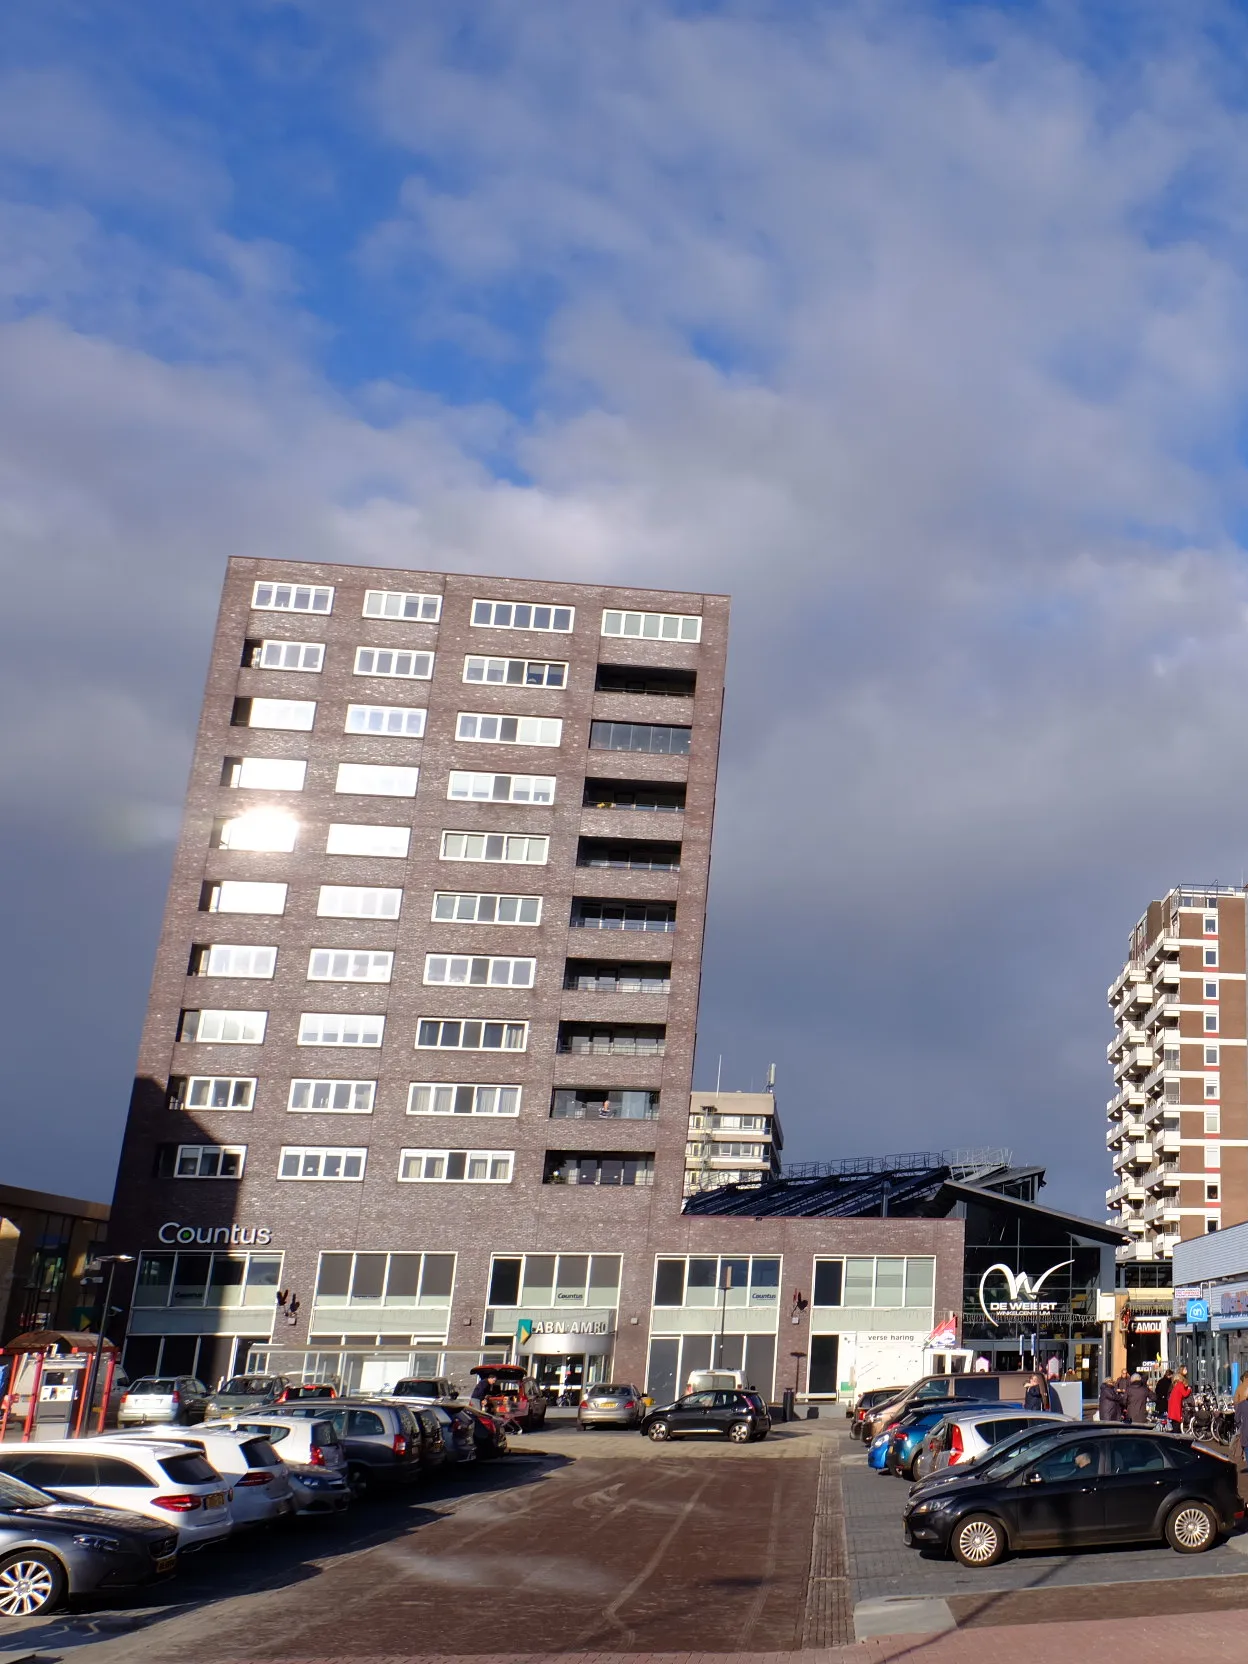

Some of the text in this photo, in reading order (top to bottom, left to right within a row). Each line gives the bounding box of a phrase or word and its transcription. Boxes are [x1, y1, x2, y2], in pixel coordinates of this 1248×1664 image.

[158, 1222, 272, 1245] Countus
[990, 1302, 1008, 1311] DE
[890, 1334, 915, 1342] haring
